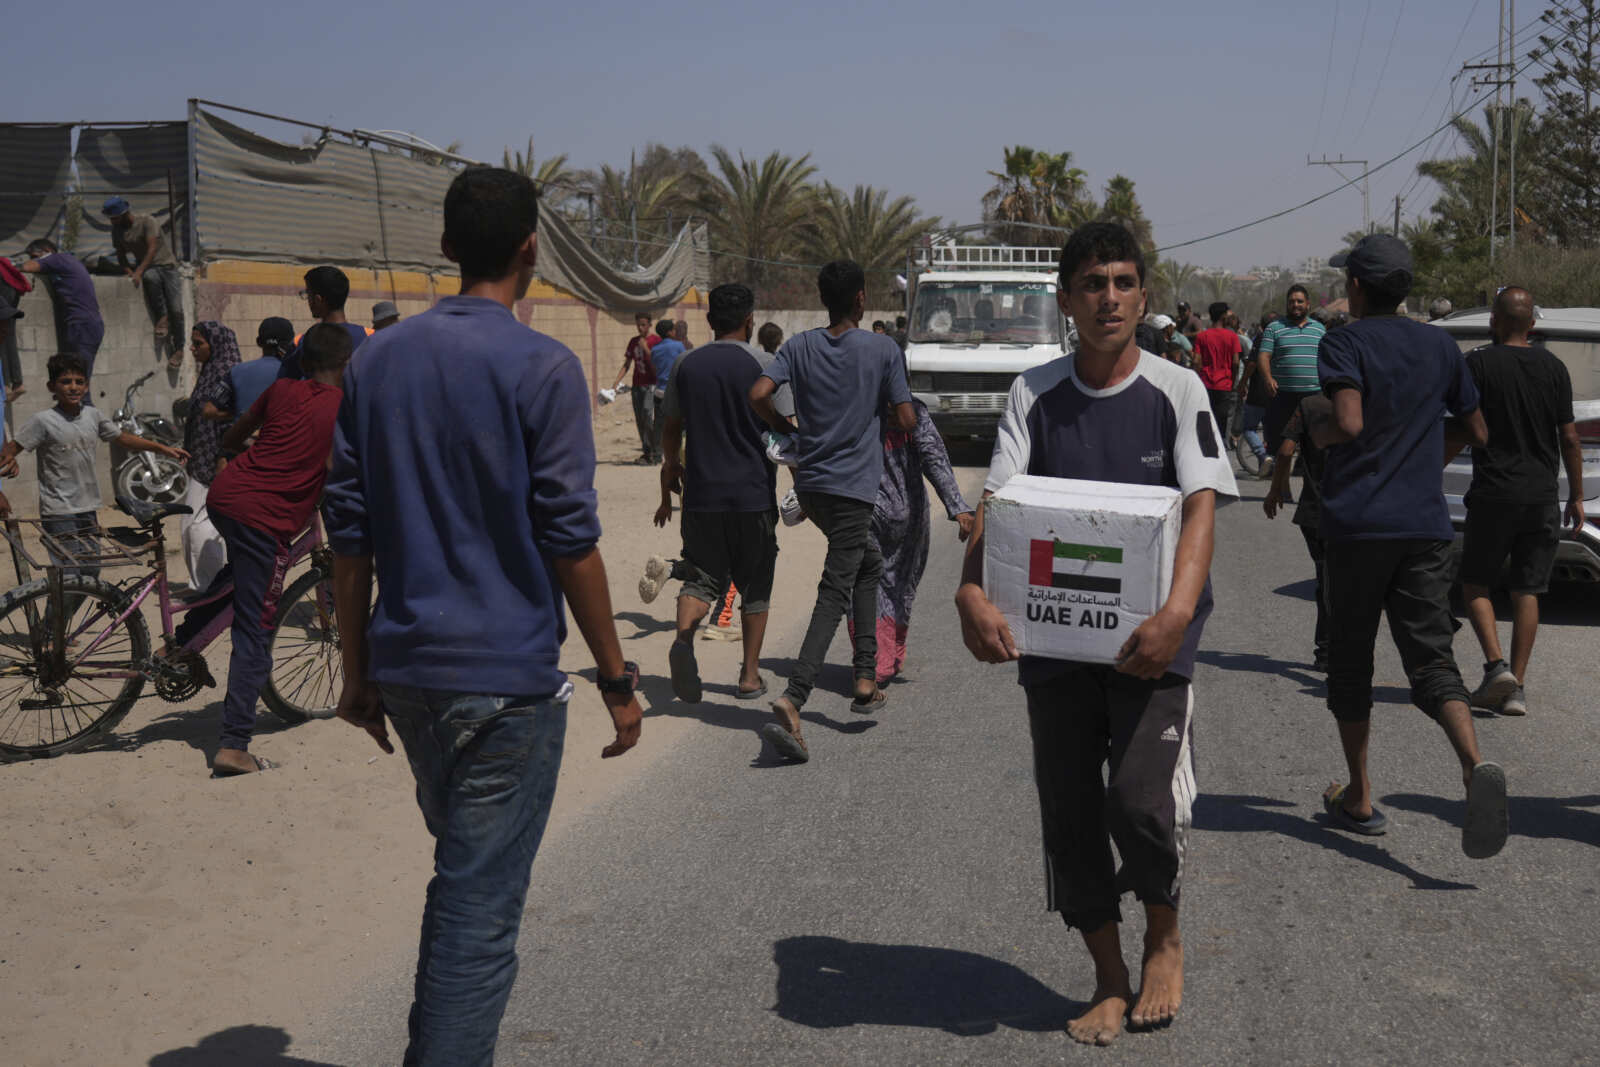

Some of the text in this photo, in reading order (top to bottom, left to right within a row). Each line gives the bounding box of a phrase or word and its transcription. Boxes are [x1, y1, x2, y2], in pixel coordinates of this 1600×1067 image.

[1028, 587, 1121, 607] المساعدات الإماراتية
[1026, 603, 1119, 630] UAE AID
